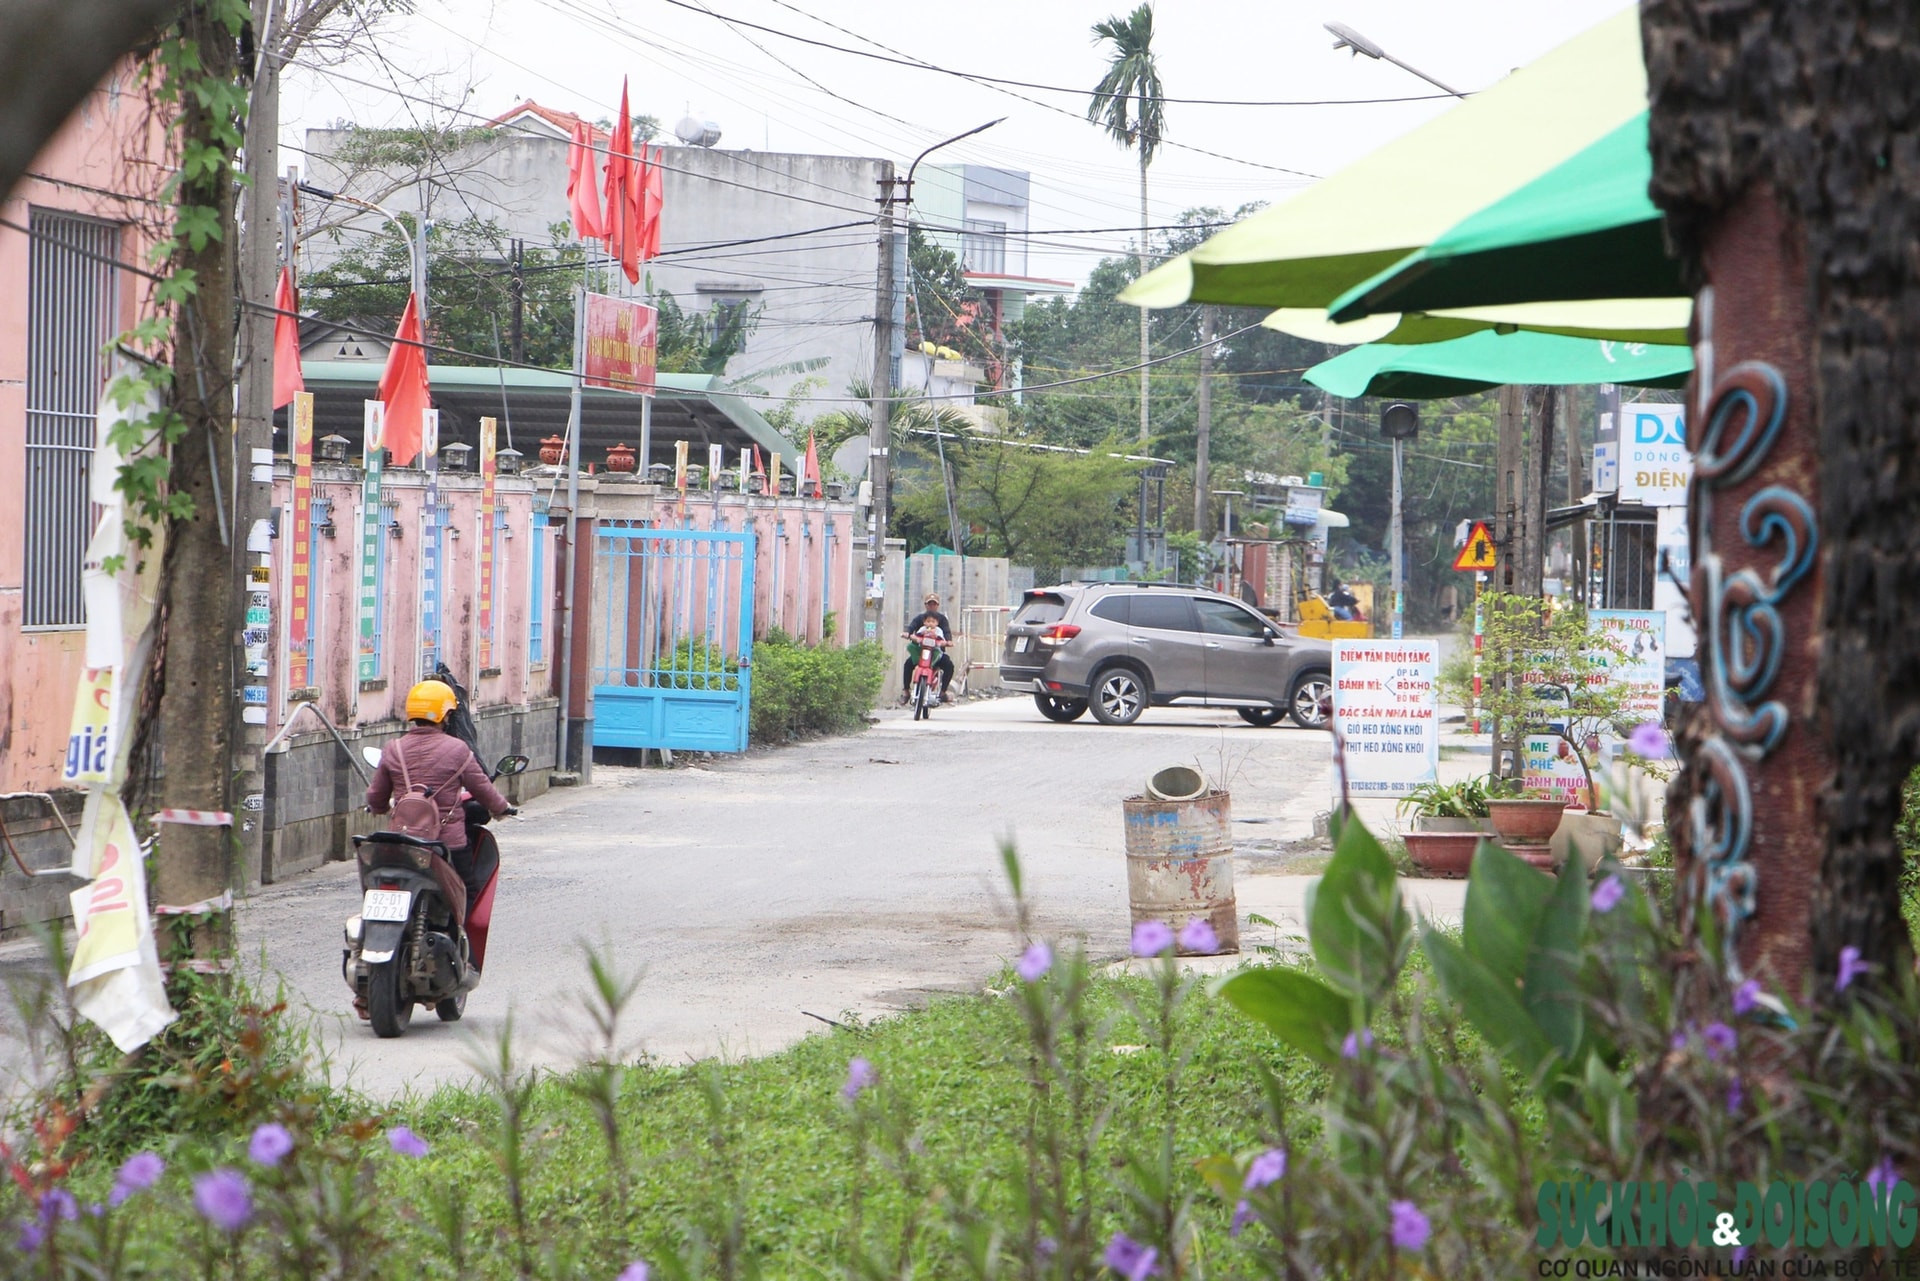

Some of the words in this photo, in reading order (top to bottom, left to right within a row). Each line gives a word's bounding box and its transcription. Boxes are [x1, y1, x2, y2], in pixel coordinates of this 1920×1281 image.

[1635, 467, 1686, 491] ĐIỆN
[1339, 679, 1363, 690] BÁNH
[1362, 724, 1378, 735] HEO
[1380, 721, 1402, 735] XÔNG
[1346, 741, 1362, 755] THỊT
[1363, 742, 1380, 753] HEO
[1381, 740, 1404, 754] XÔNG
[1530, 742, 1550, 753] ME
[1530, 757, 1554, 770] PHÊ
